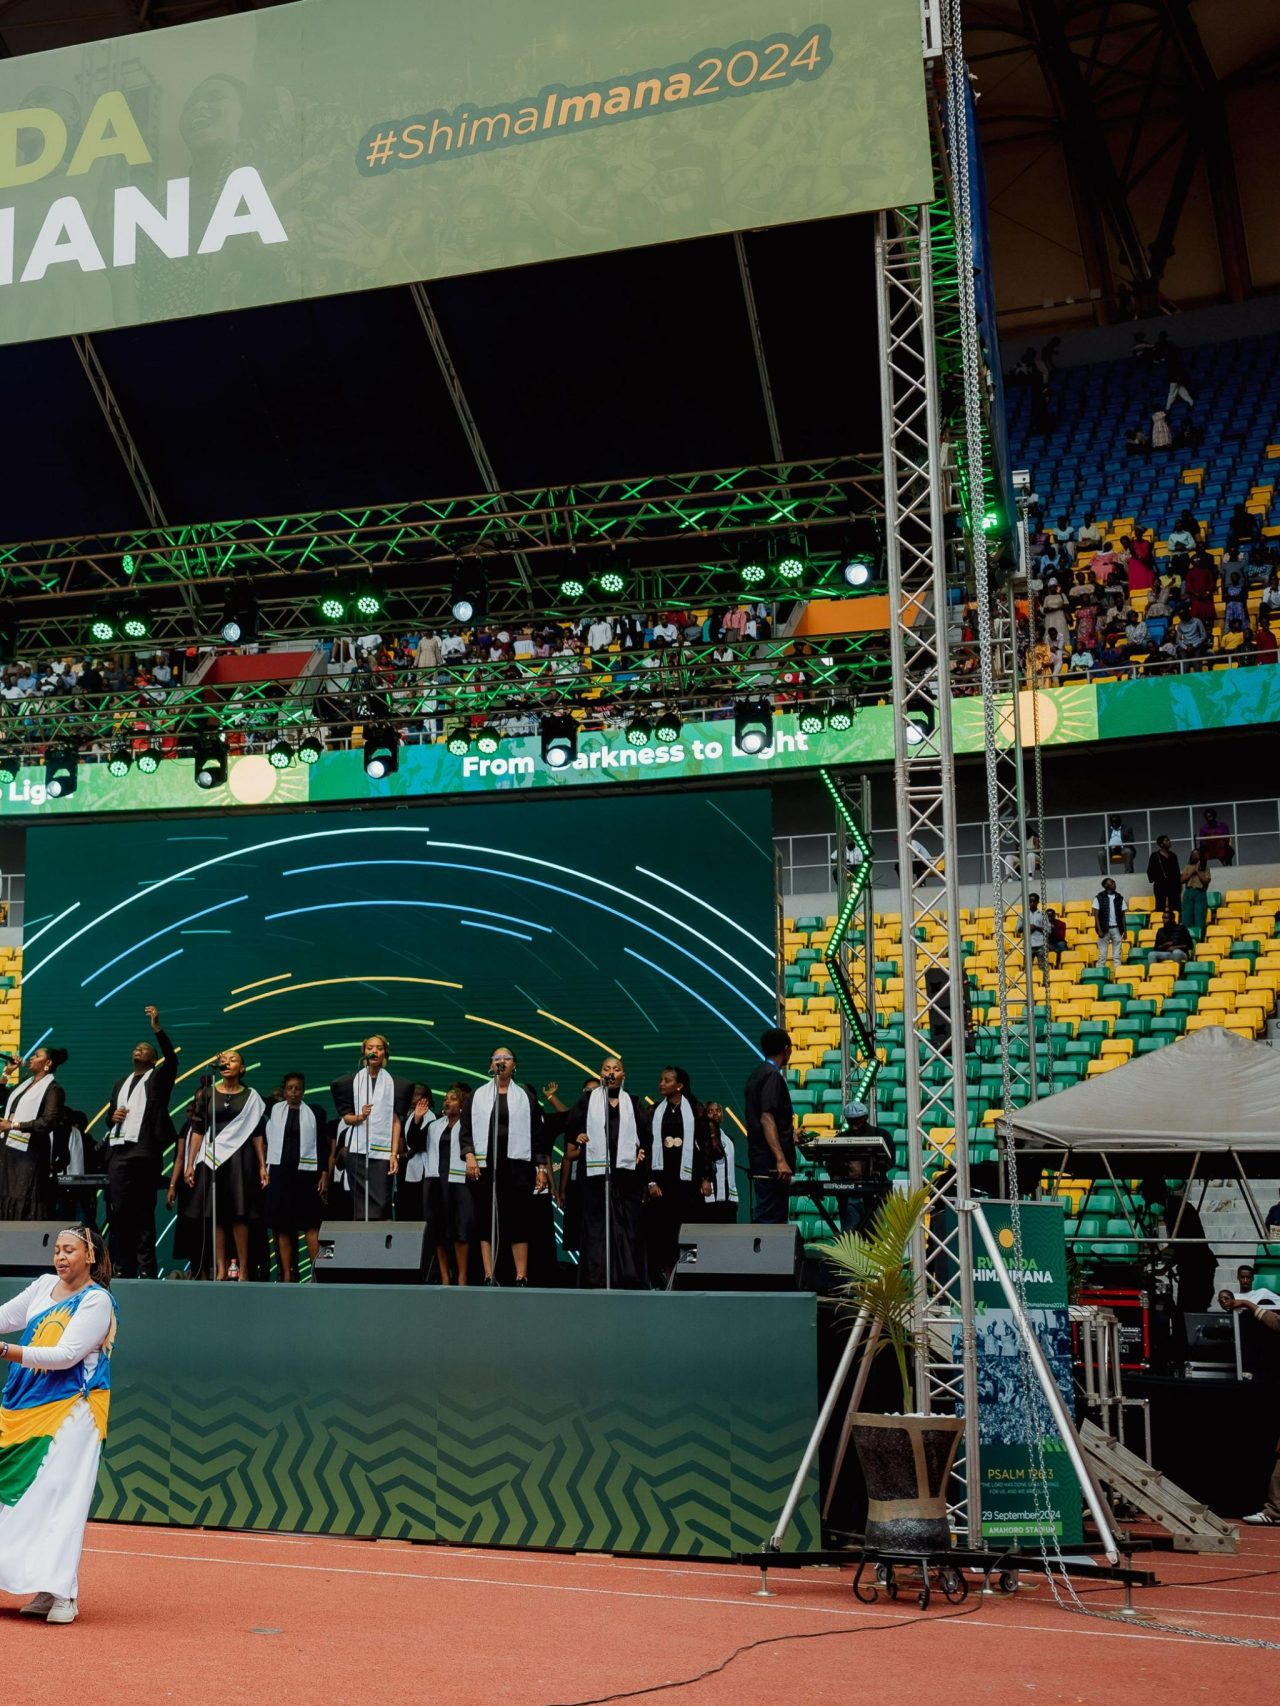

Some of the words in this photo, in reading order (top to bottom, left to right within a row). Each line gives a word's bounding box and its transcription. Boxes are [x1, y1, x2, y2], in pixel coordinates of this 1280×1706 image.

[365, 34, 822, 168] #ShimaImana2024
[463, 755, 535, 777] From
[551, 741, 685, 772] arkness
[692, 740, 723, 761] to
[9, 779, 74, 807] Lig
[988, 1469, 1024, 1480] PSALM
[982, 1511, 992, 1520] 29
[994, 1510, 1038, 1521] September
[1040, 1510, 1061, 1520] 2024
